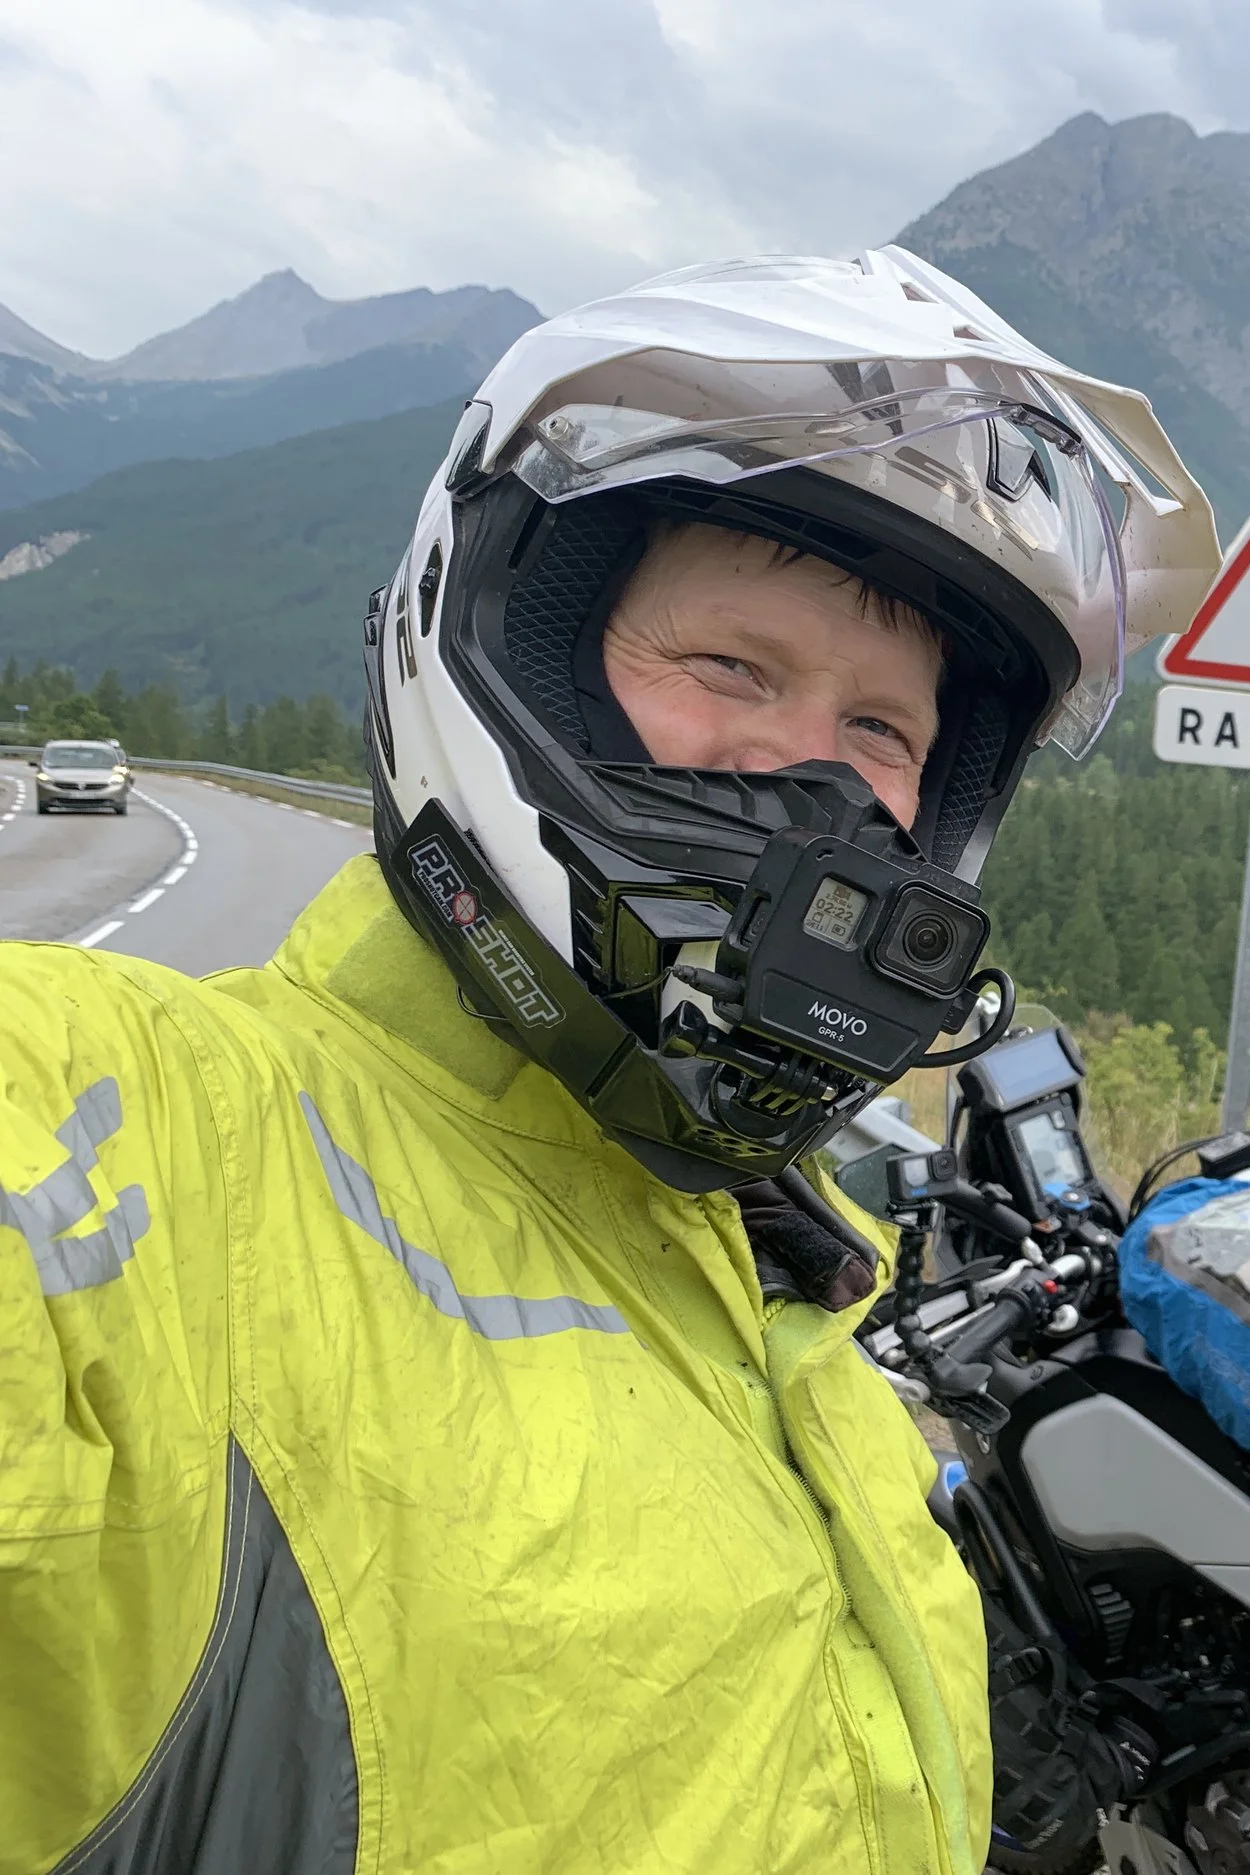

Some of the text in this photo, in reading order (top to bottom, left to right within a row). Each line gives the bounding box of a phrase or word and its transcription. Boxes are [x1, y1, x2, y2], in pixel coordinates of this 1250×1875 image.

[816, 898, 853, 922] 02:22
[807, 1000, 868, 1036] MOVO
[818, 1026, 845, 1042] GPR-5
